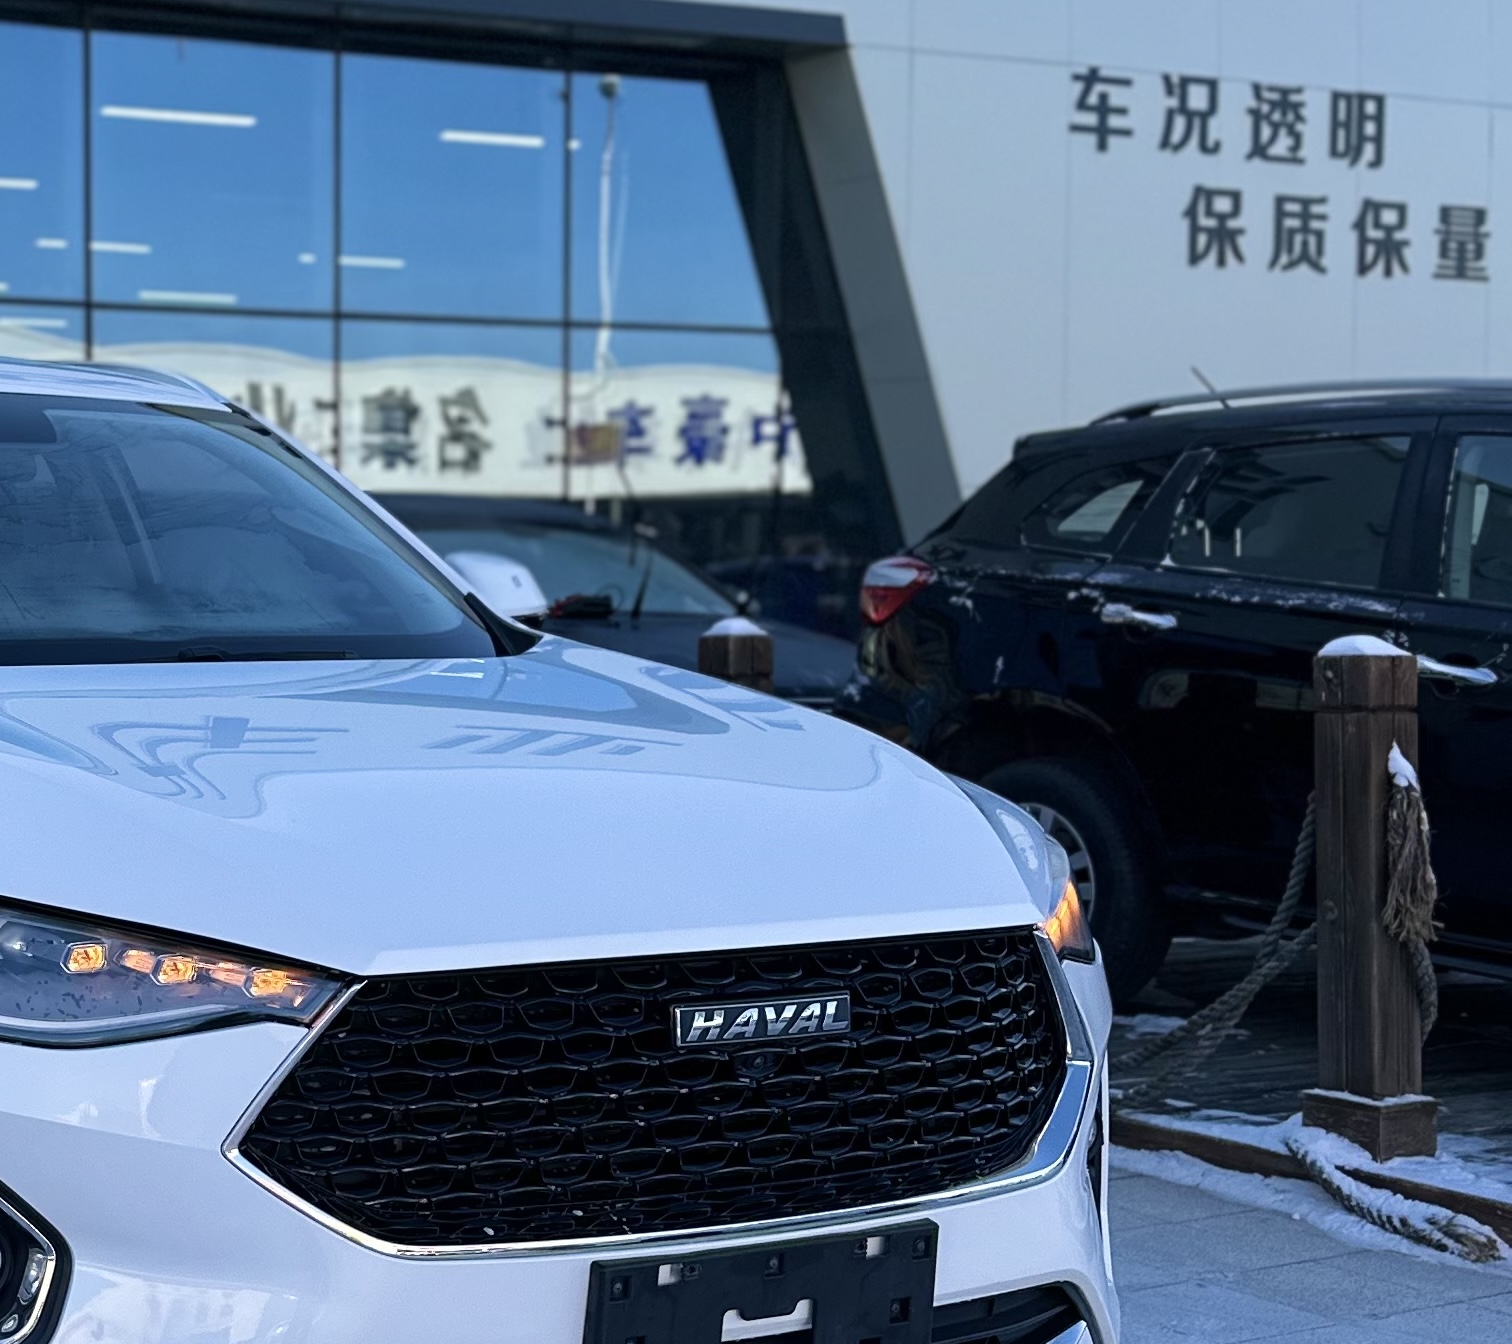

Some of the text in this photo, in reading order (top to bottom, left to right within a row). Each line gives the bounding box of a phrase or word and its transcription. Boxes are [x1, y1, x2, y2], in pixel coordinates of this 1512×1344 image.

[1069, 66, 1387, 170] 车况透明
[1182, 184, 1491, 284] 保质保量
[686, 1000, 849, 1042] HAVAL
